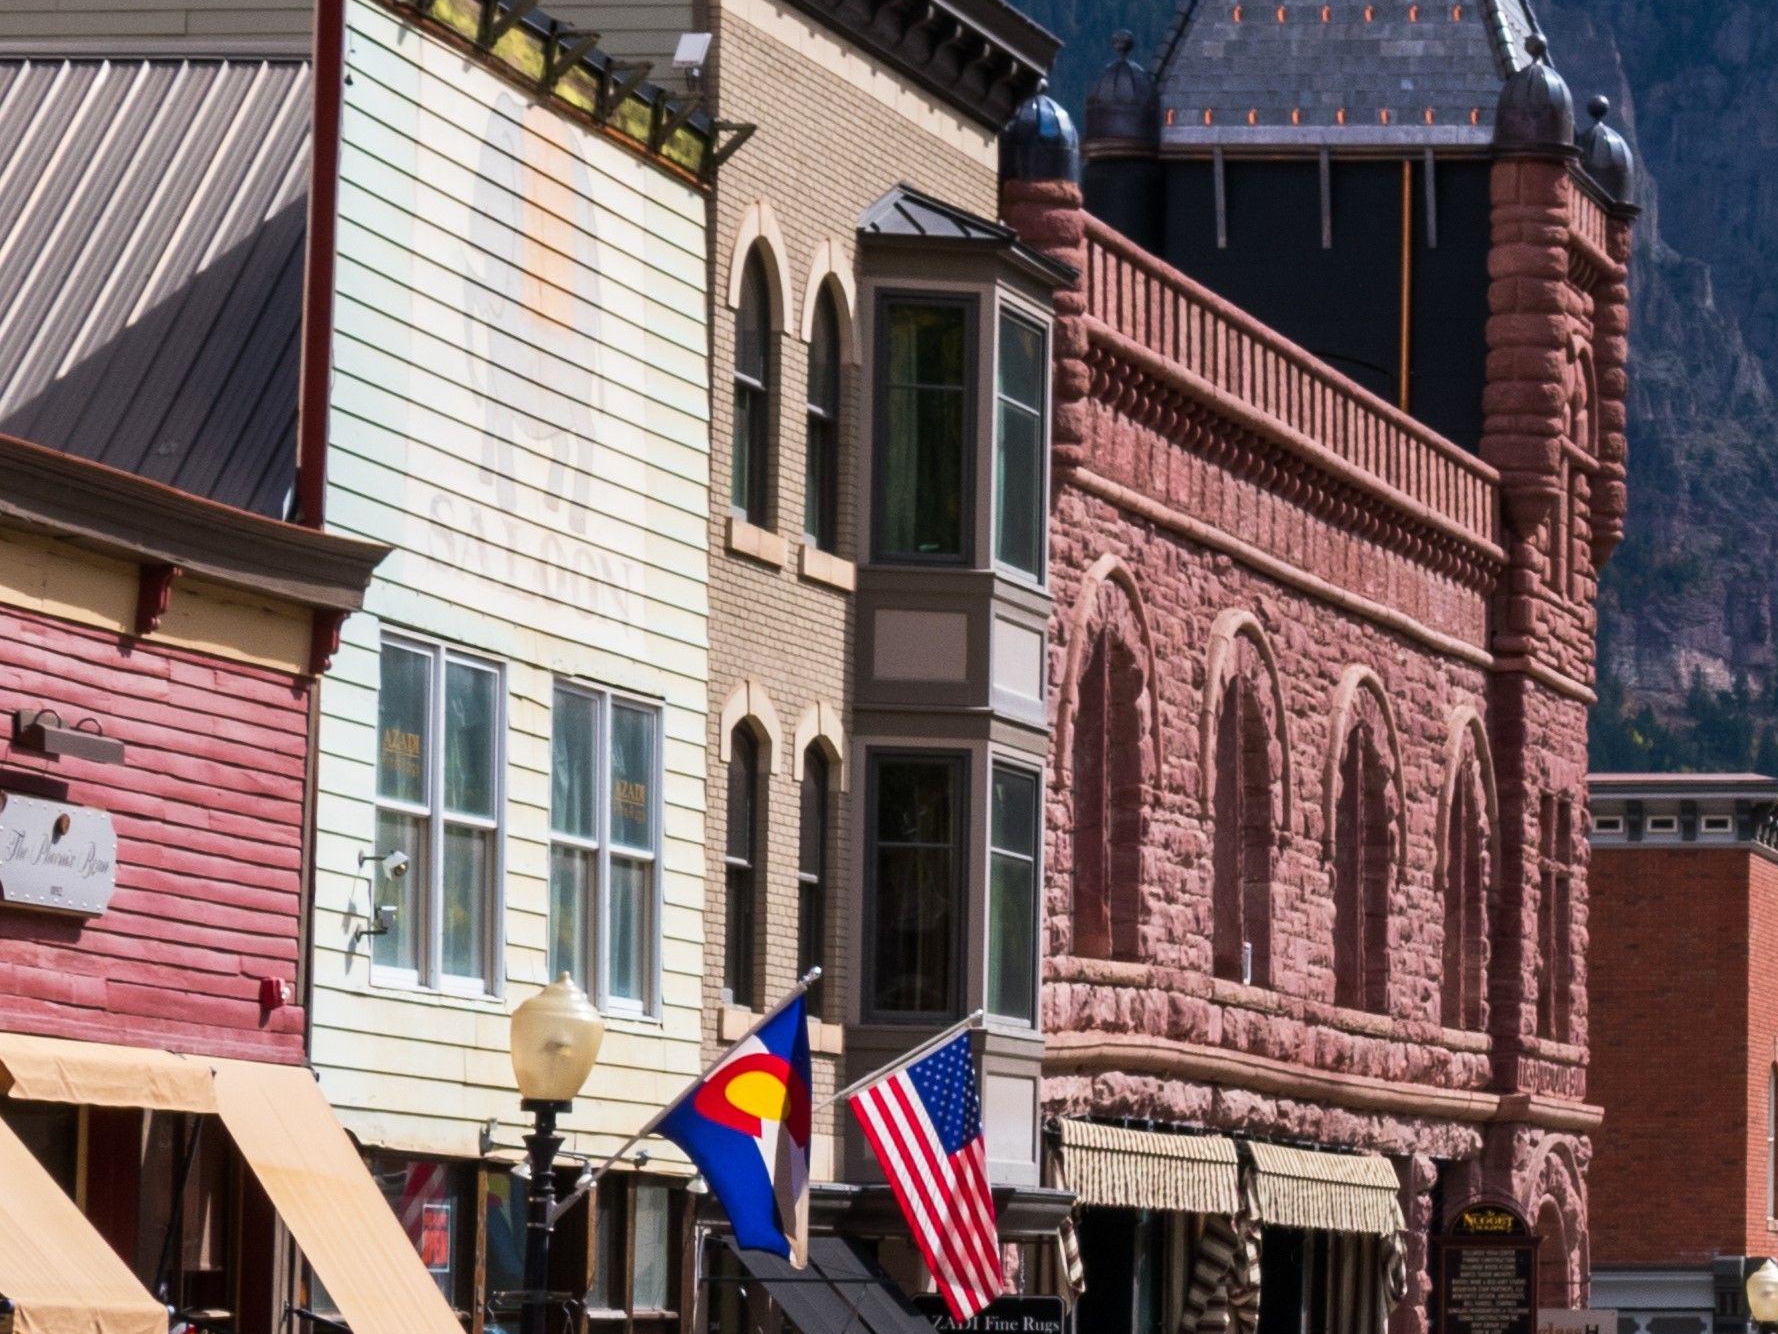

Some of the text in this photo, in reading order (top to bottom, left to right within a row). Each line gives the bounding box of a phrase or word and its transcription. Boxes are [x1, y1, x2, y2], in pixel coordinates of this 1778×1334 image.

[426, 494, 632, 637] SALOON
[6, 829, 28, 861] The
[932, 1315, 1060, 1334] ZADI Fine Rugs
